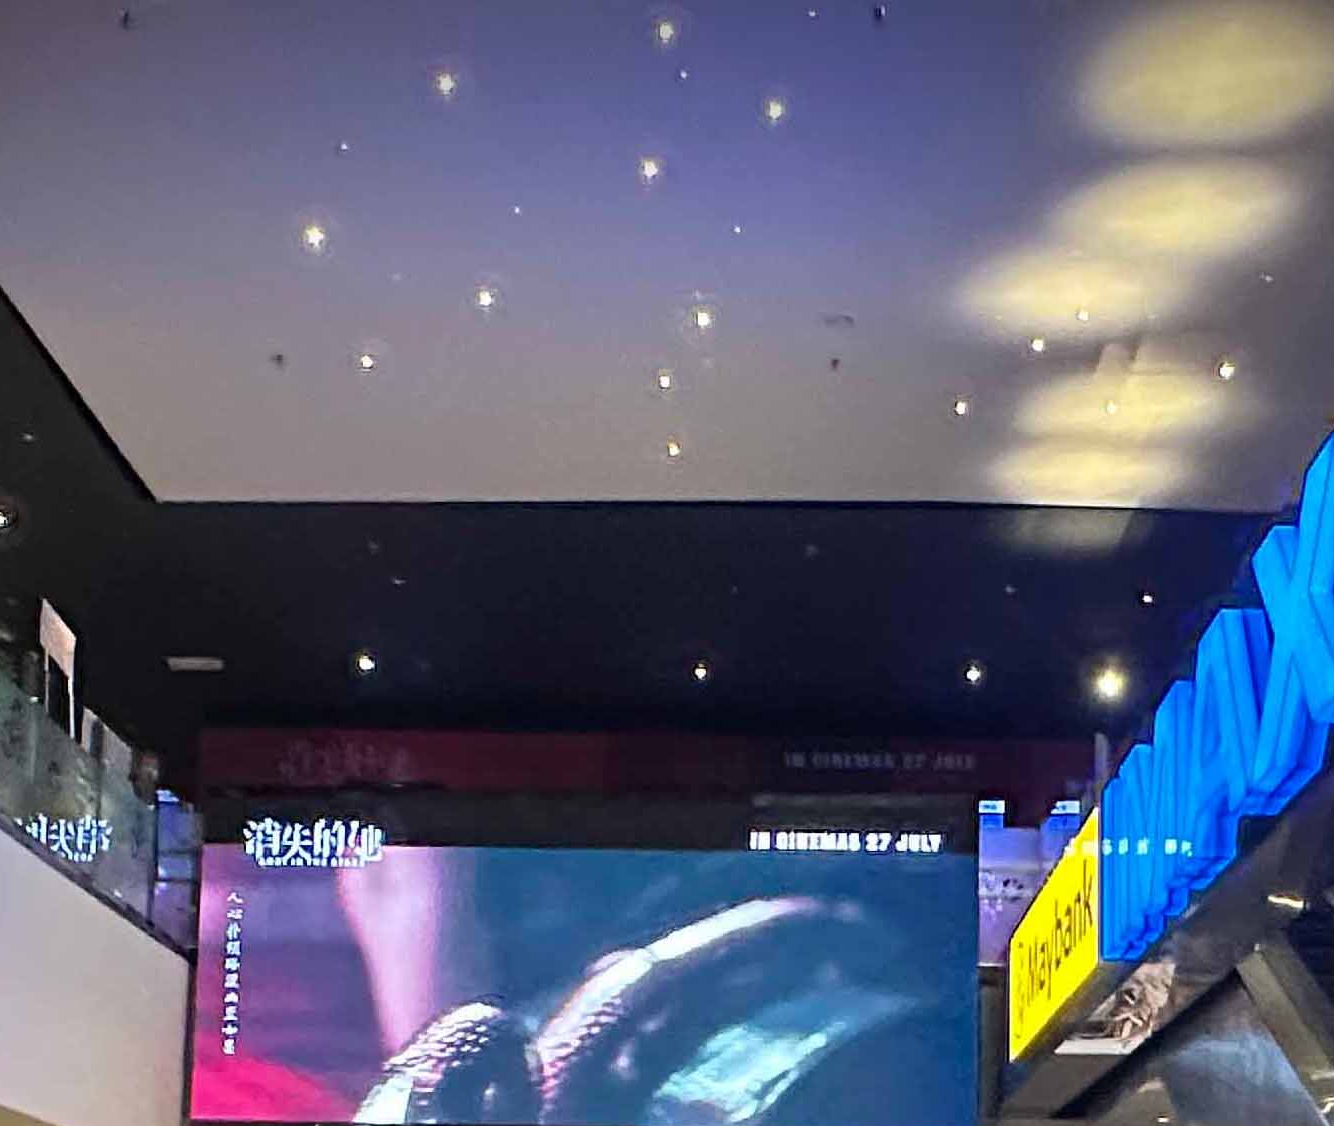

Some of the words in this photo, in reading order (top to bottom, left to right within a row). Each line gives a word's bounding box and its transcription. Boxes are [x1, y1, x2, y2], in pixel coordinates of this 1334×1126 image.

[749, 831, 771, 850] IN
[775, 831, 861, 851] CINEMAS
[865, 832, 892, 851] 27
[895, 833, 942, 852] JULY
[1027, 857, 1094, 1009] Maybank
